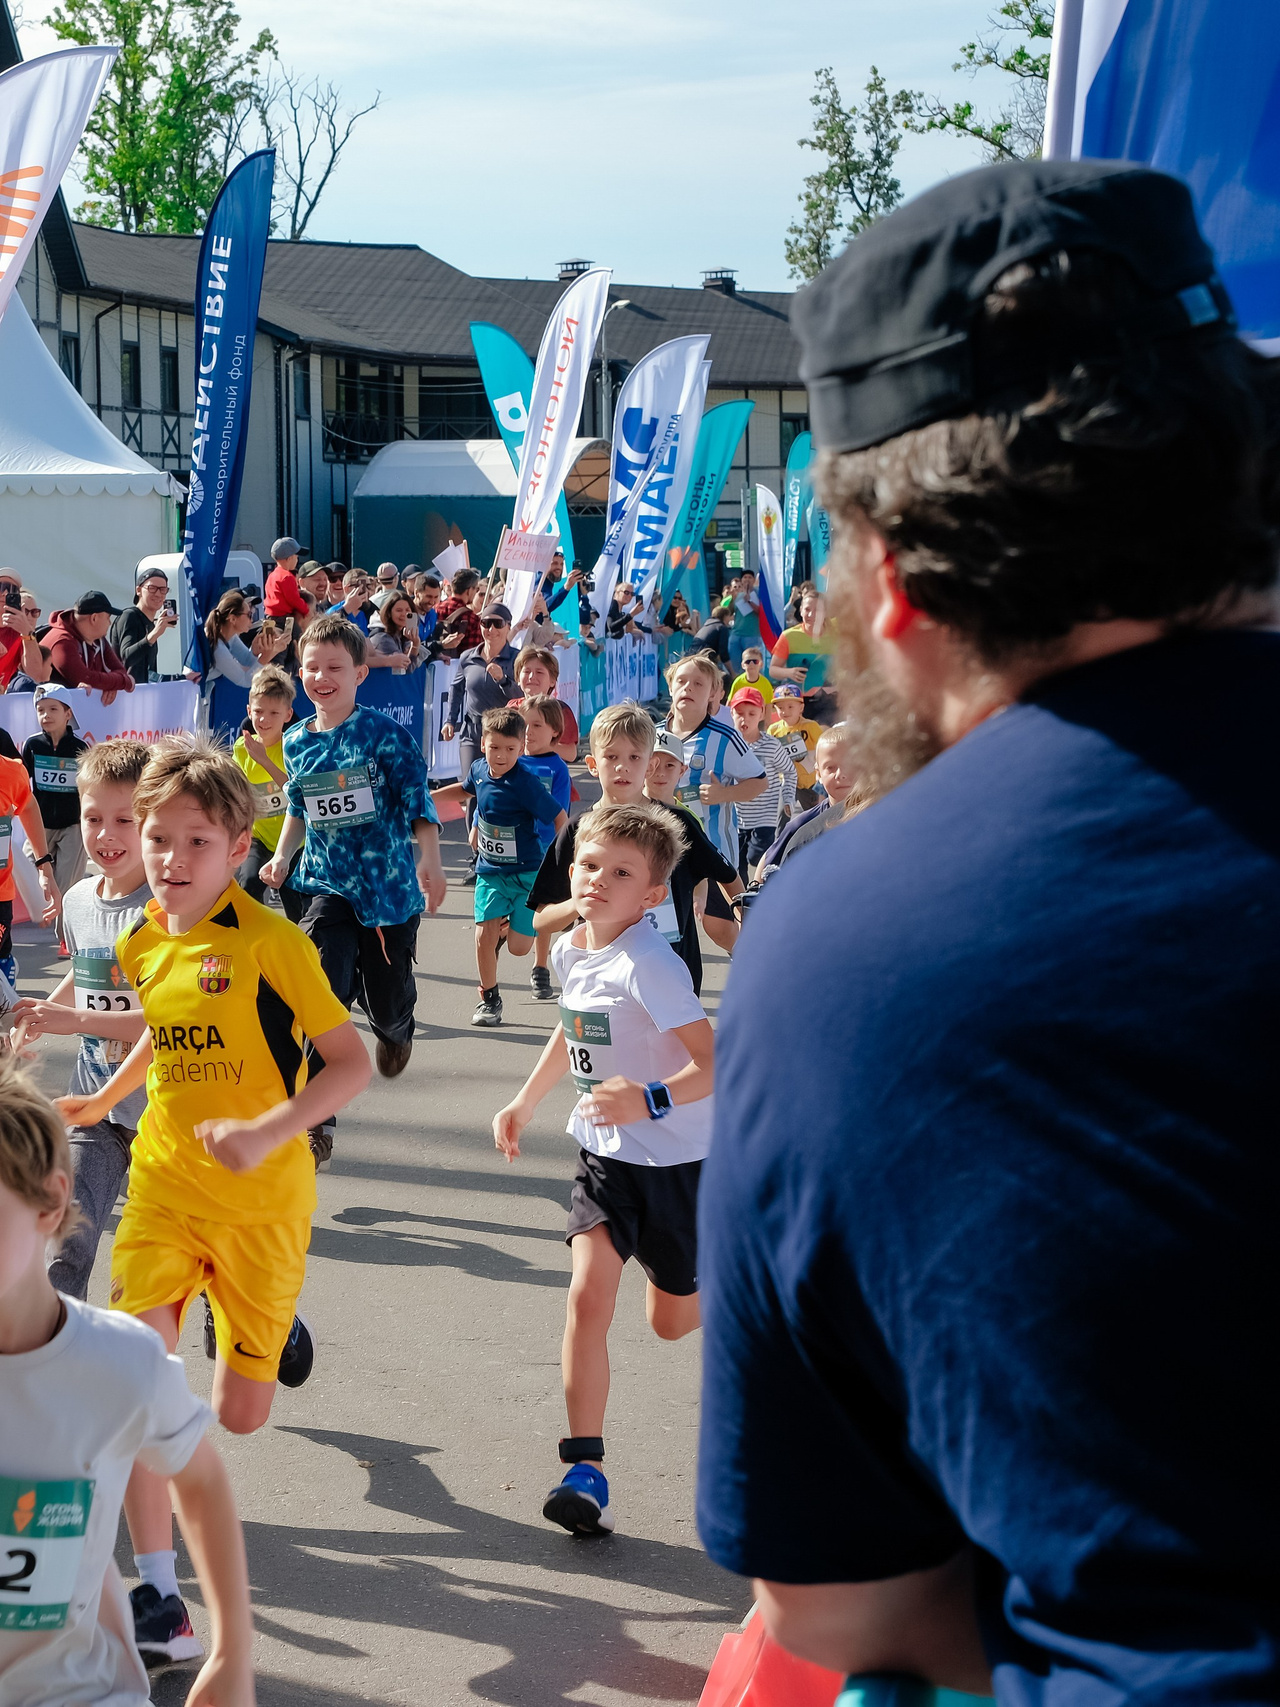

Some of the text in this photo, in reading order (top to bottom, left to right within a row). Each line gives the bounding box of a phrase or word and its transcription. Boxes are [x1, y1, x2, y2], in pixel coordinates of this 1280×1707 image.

[208, 334, 247, 555] благотворительный фонд
[42, 772, 67, 784] 576
[317, 794, 357, 817] 565
[481, 837, 504, 854] 566
[584, 1031, 608, 1039] ЖИЗНИ
[41, 1502, 83, 1515] ОГОНЬ
[36, 1511, 84, 1527] ЖИЗНИ
